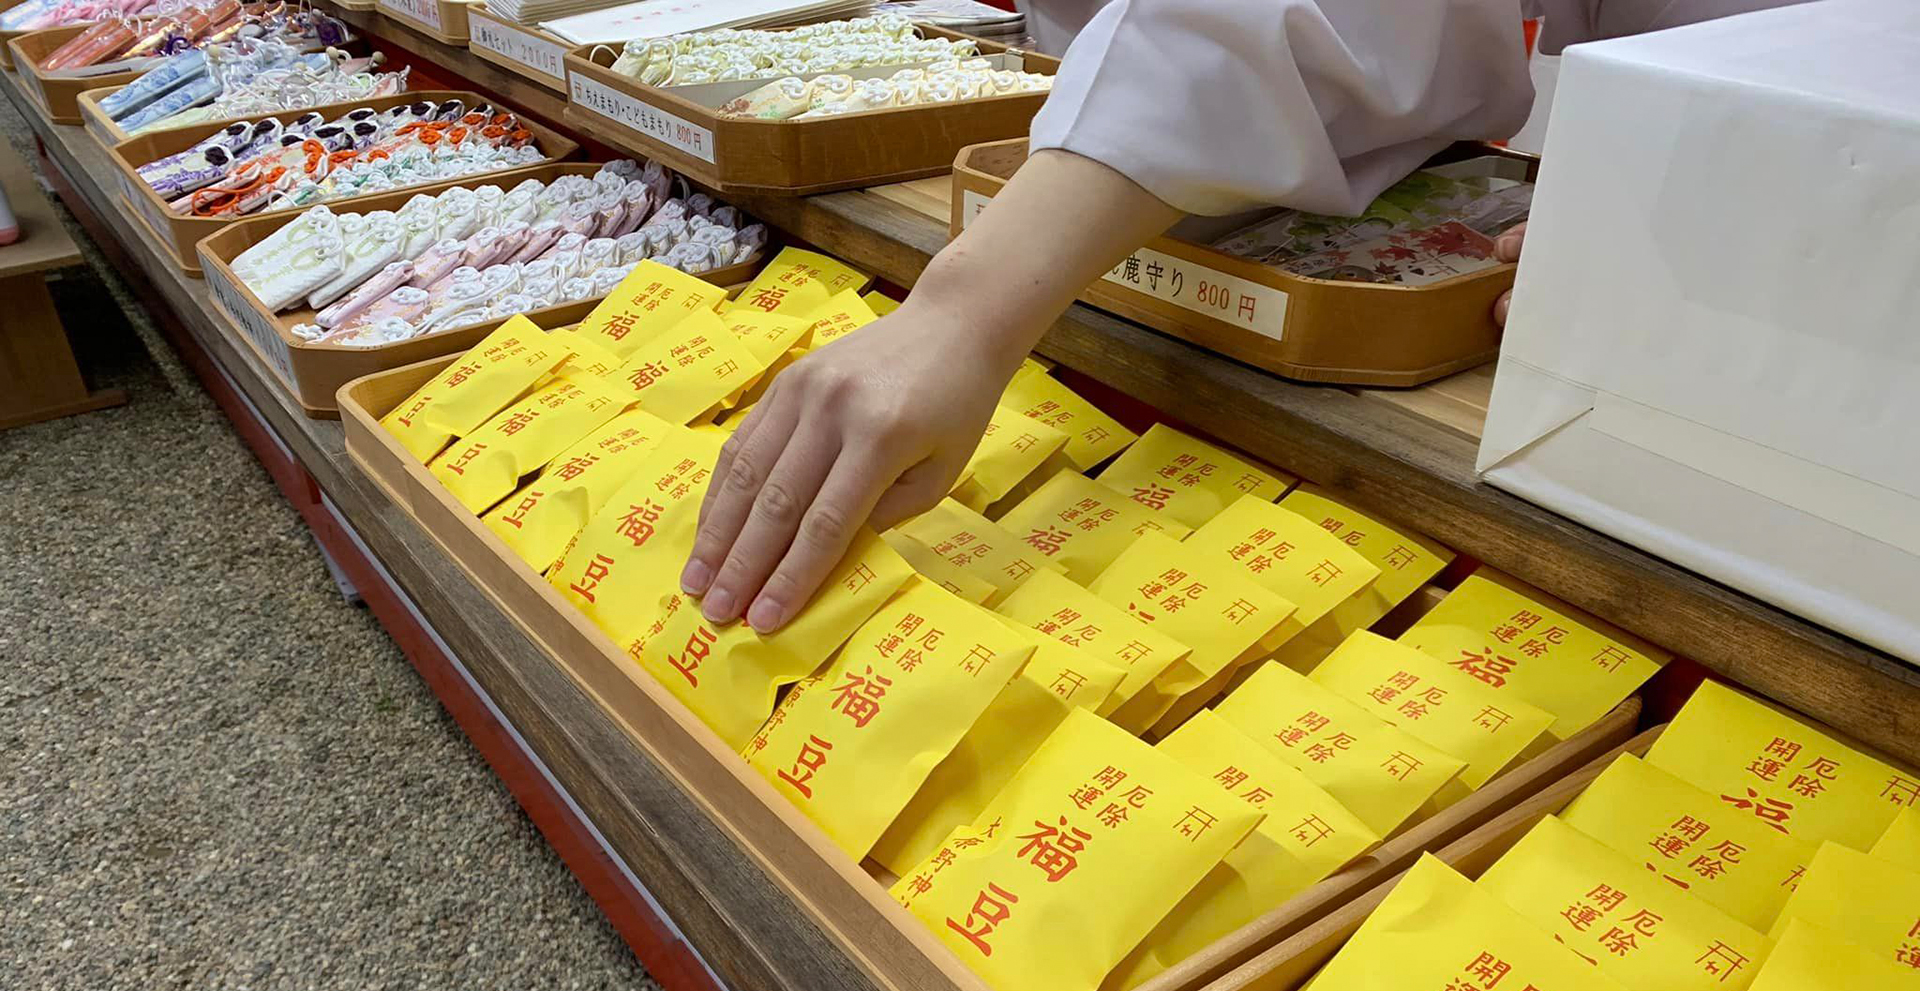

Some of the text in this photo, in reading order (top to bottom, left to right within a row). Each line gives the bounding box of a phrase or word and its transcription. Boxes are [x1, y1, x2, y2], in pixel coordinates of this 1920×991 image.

[1112, 254, 1184, 297] 鹿守り
[750, 286, 789, 312] 福
[601, 310, 640, 341] 福
[626, 359, 670, 391] 福
[447, 408, 540, 475] 福豆
[655, 458, 697, 492] 開運
[1156, 453, 1199, 479] 開運
[1178, 463, 1219, 488] 厄除
[502, 452, 601, 530] 福豆
[668, 468, 711, 501] 厄除
[1129, 482, 1176, 511] 福
[1057, 497, 1100, 523] 開運
[1076, 508, 1120, 532] 厄除
[570, 497, 664, 604] 福豆
[1021, 525, 1073, 557] 福
[1227, 527, 1277, 561] 開運
[1245, 541, 1295, 574] 厄除
[1137, 568, 1188, 600] 開運
[1159, 582, 1208, 613] 厄除
[874, 613, 924, 659] 開運
[1489, 609, 1542, 645] 開運
[1518, 625, 1572, 659] 厄除
[896, 628, 945, 673] 厄除
[1447, 646, 1518, 689] 福
[1366, 670, 1419, 706] 開運
[1397, 686, 1449, 721] 厄除
[777, 664, 893, 799] 福豆
[1274, 710, 1331, 747] 開運
[1303, 729, 1358, 765] 厄除
[1745, 736, 1802, 782] 開運
[1068, 764, 1128, 811] 開運
[1788, 755, 1842, 799] 厄除
[1096, 784, 1155, 830] 厄除
[1648, 815, 1710, 858] 開運
[1687, 838, 1748, 881] 厄除
[946, 814, 1093, 957] 福豆
[1559, 883, 1628, 932] 開運
[1597, 908, 1664, 958] 厄除
